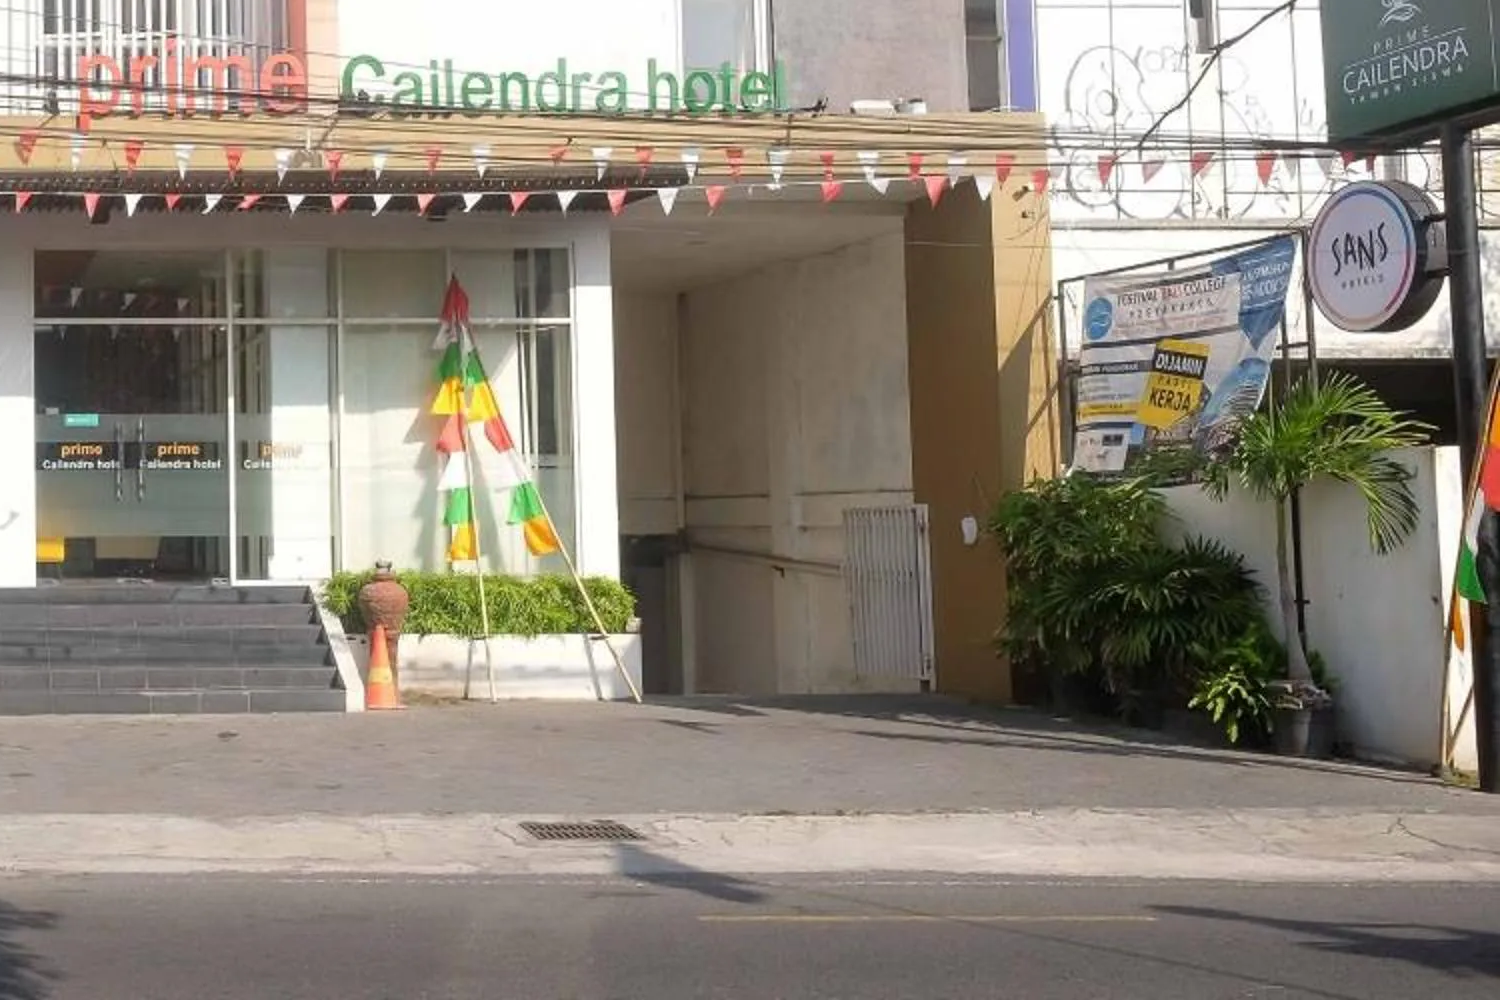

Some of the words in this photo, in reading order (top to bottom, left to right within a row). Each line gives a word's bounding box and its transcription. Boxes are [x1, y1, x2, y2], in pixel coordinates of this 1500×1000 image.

[1373, 24, 1429, 54] PRIME
[1343, 35, 1469, 93] CAILENDRA
[76, 37, 308, 135] prime
[341, 54, 638, 117] Cailendra
[647, 57, 787, 117] hotel
[1332, 221, 1388, 276] SANS
[1155, 352, 1203, 376] DIJAMIN
[1150, 388, 1192, 412] KERJA
[61, 443, 103, 458] prime
[157, 442, 200, 457] prime
[42, 460, 94, 470] Cailendra
[193, 459, 221, 470] hotel
